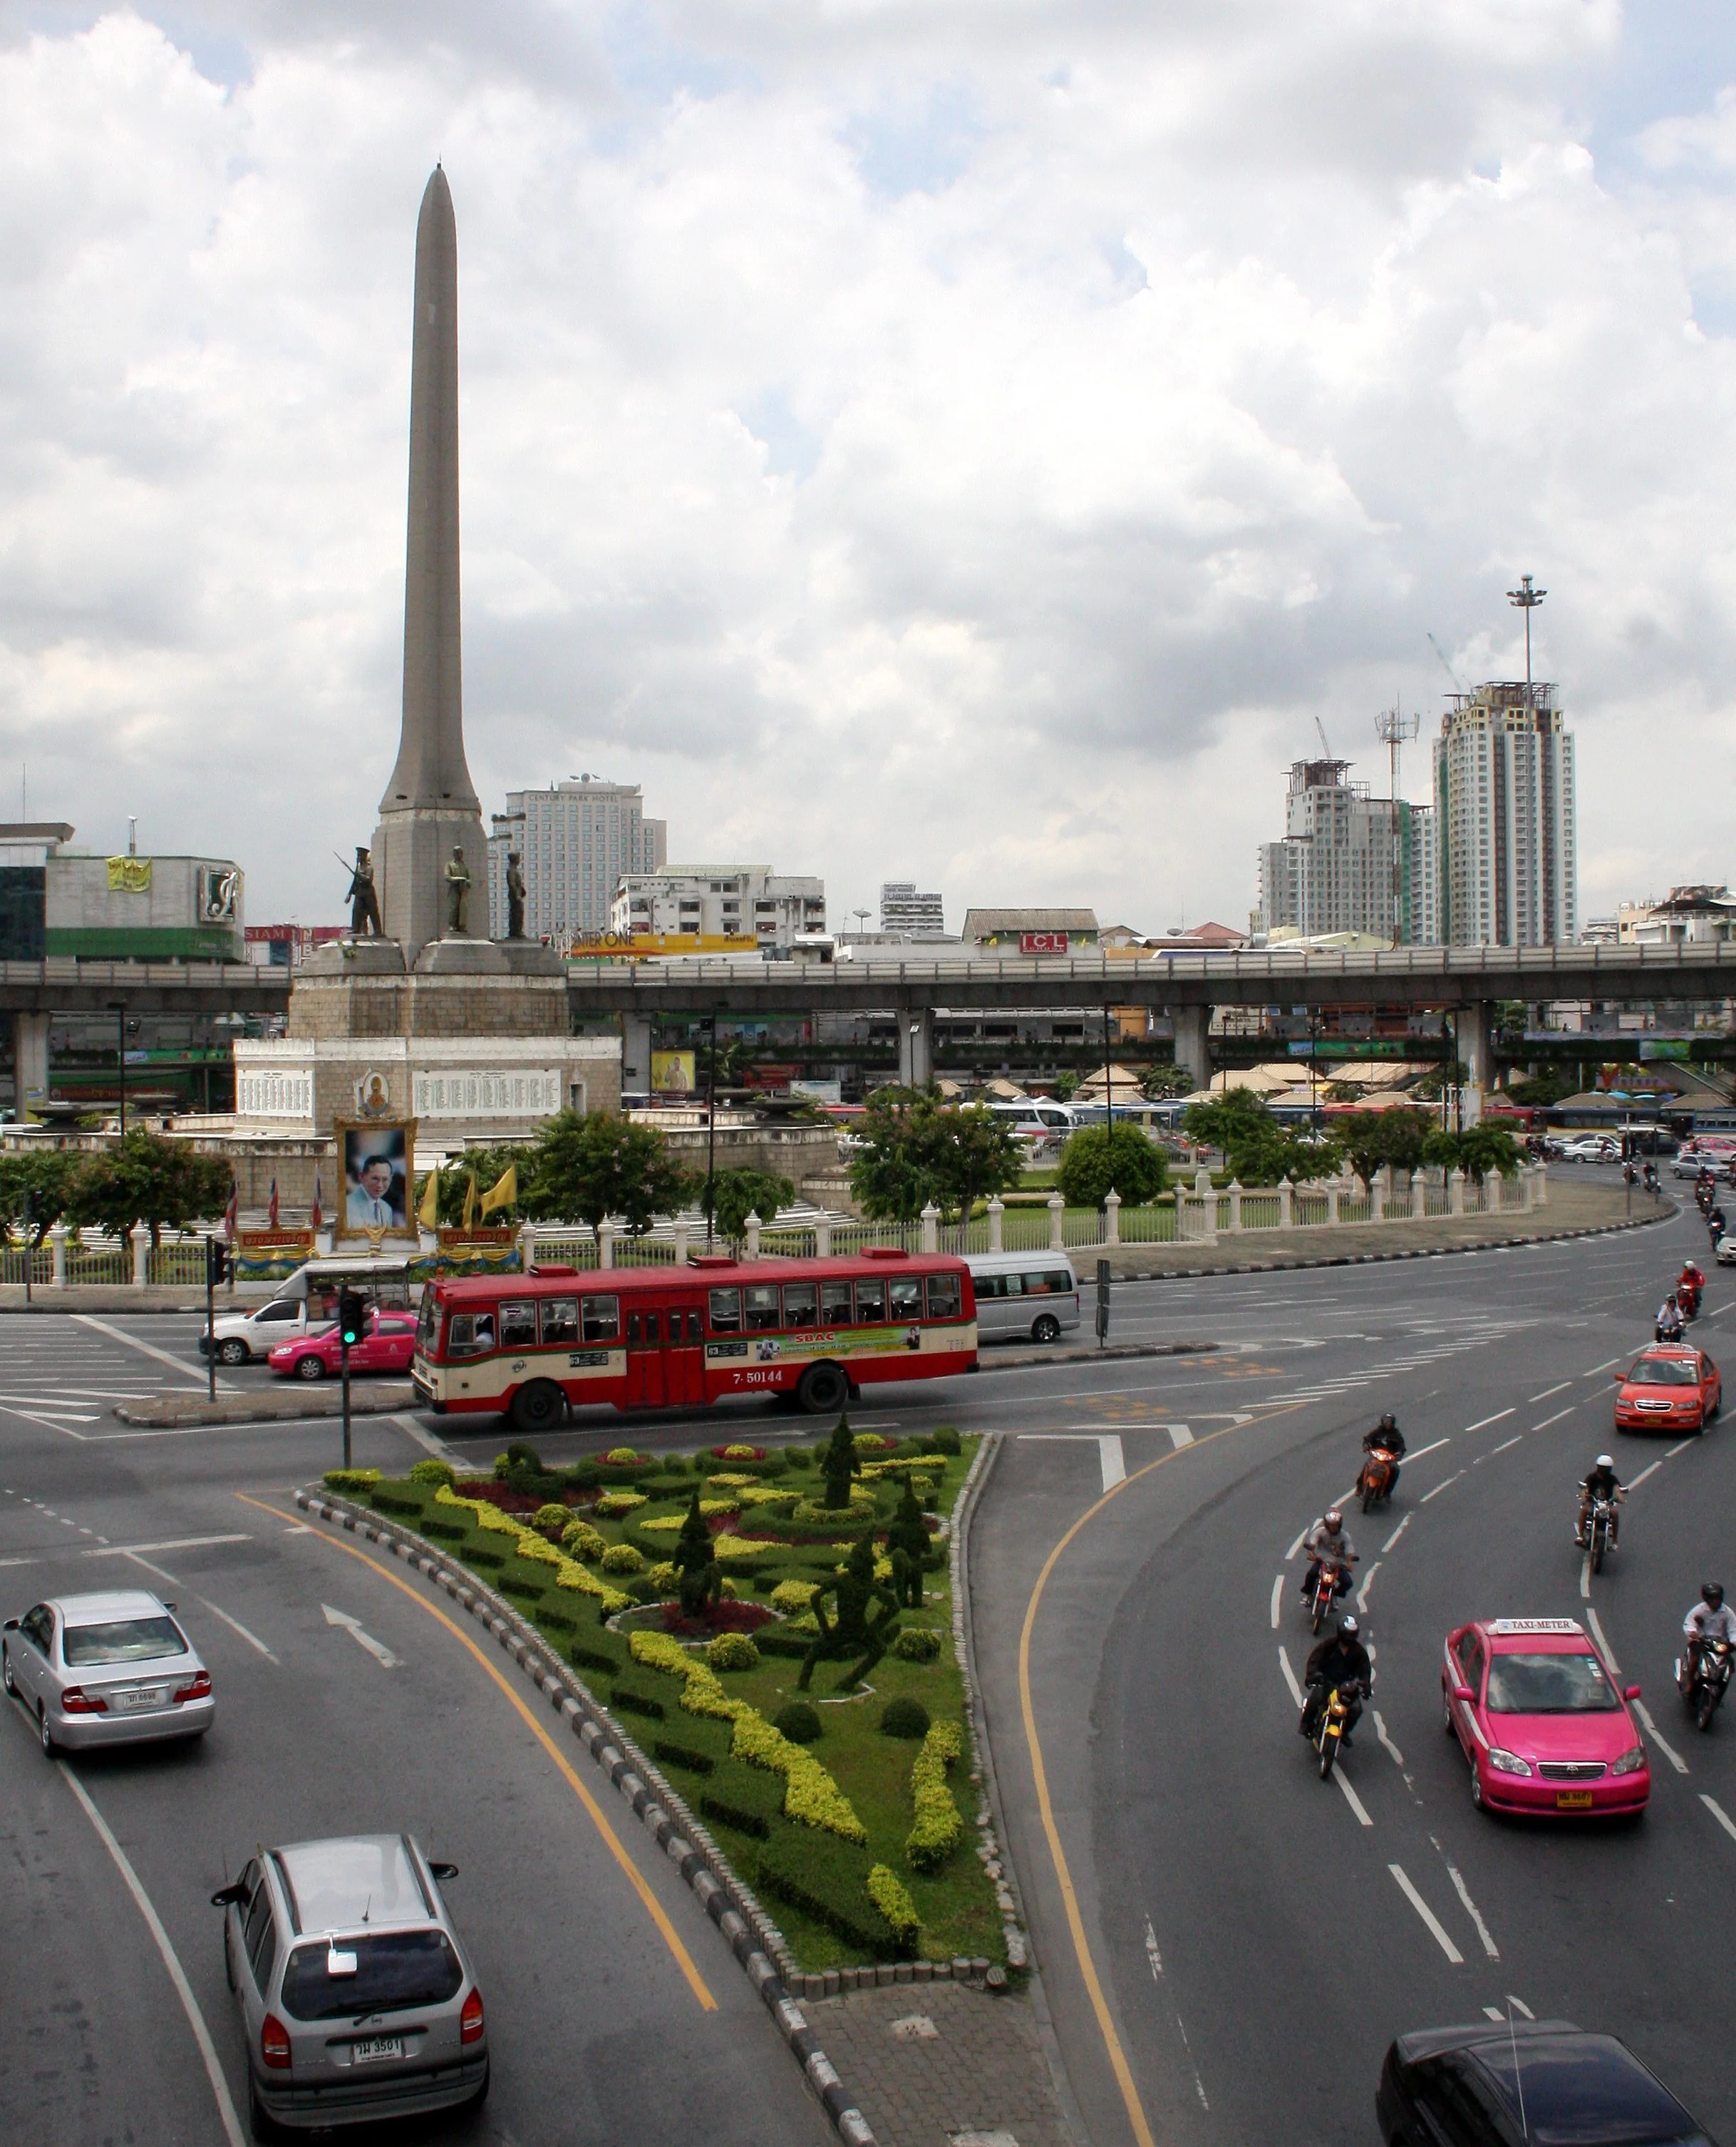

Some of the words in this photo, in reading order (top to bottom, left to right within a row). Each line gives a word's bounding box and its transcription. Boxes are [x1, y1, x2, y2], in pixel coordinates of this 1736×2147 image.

[245, 928, 284, 939] SIAM
[605, 931, 635, 947] ONE
[1023, 935, 1064, 947] ICL
[795, 1332, 835, 1344] SBAC
[747, 1370, 782, 1383] 50144
[375, 2039, 399, 2052] 3501
